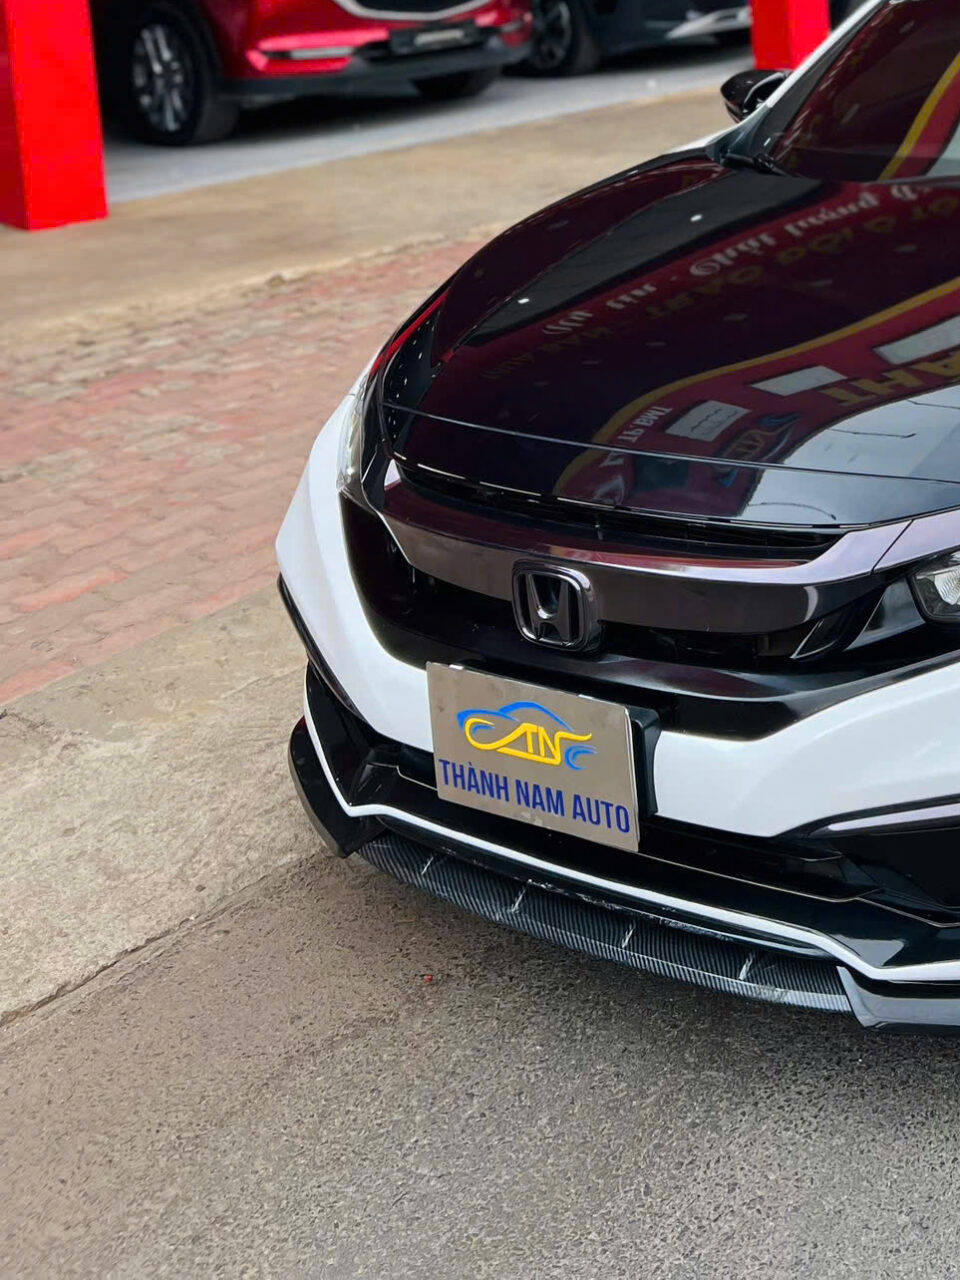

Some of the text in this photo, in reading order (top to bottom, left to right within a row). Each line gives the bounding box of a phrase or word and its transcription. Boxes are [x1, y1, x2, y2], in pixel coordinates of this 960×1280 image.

[438, 758, 630, 834] THÀNH NAM AUTO
